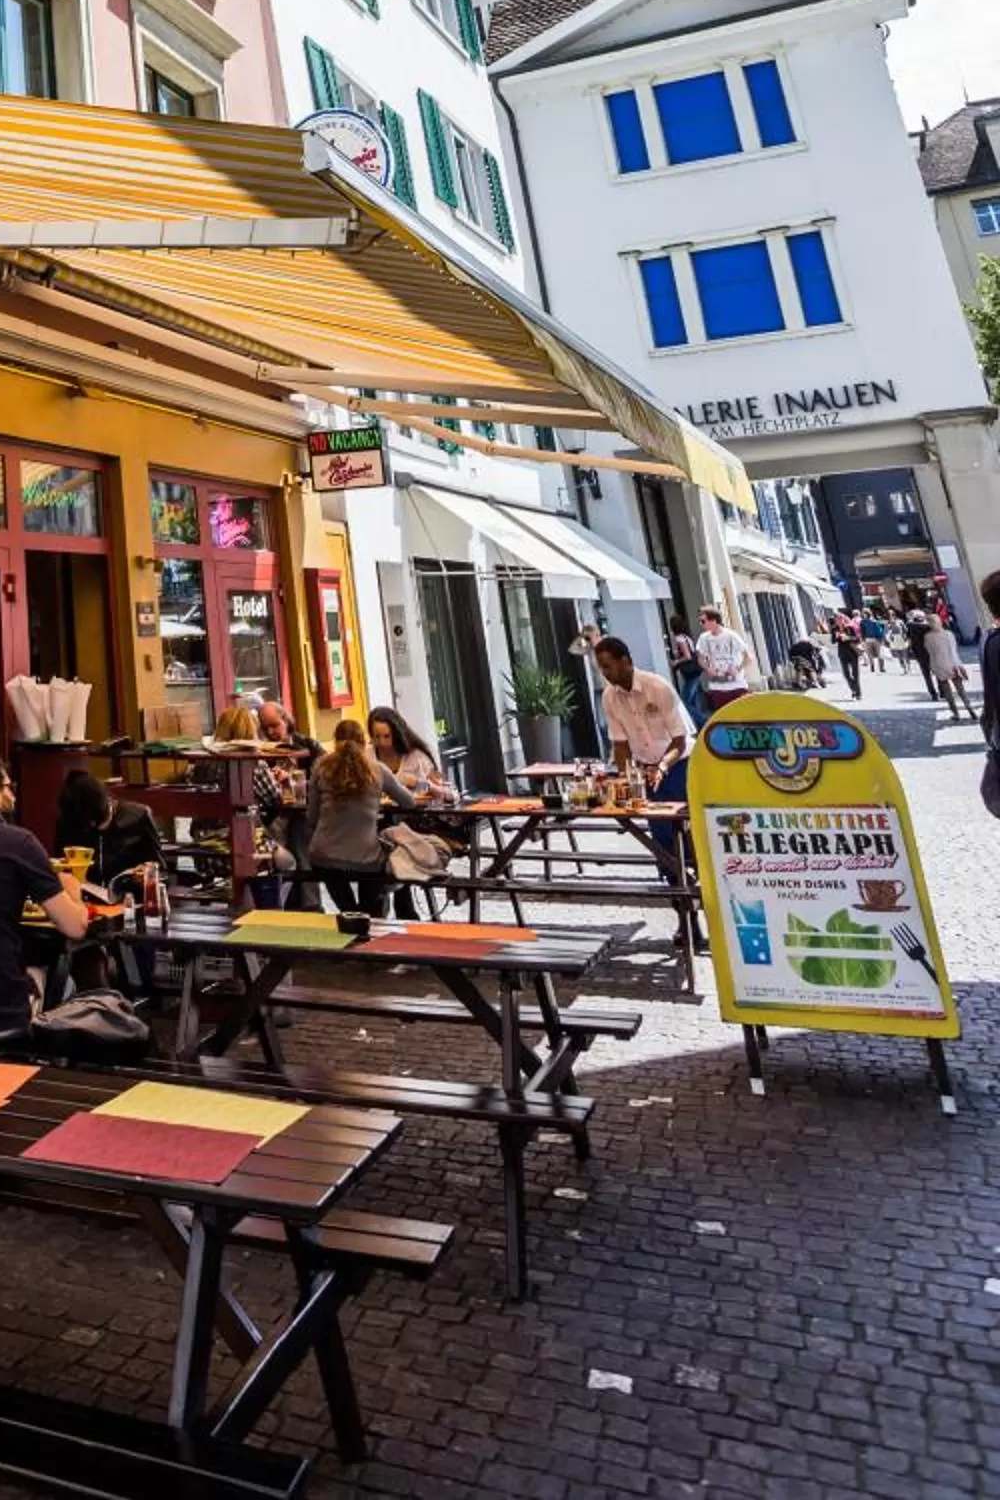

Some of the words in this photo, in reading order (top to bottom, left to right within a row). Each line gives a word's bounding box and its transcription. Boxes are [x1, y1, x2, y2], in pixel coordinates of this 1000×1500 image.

[674, 396, 764, 427] LERIE
[774, 380, 898, 415] INAUEN
[709, 426, 736, 441] AM
[743, 412, 841, 435] HECHTPLATZ
[310, 434, 327, 451] NO
[328, 429, 380, 450] VACANCY
[232, 595, 267, 617] Hotel
[727, 727, 785, 749] PAPA
[755, 812, 891, 830] LUNCHTIME
[718, 832, 897, 856] TELEGRAPH
[763, 879, 801, 889] LUNCH
